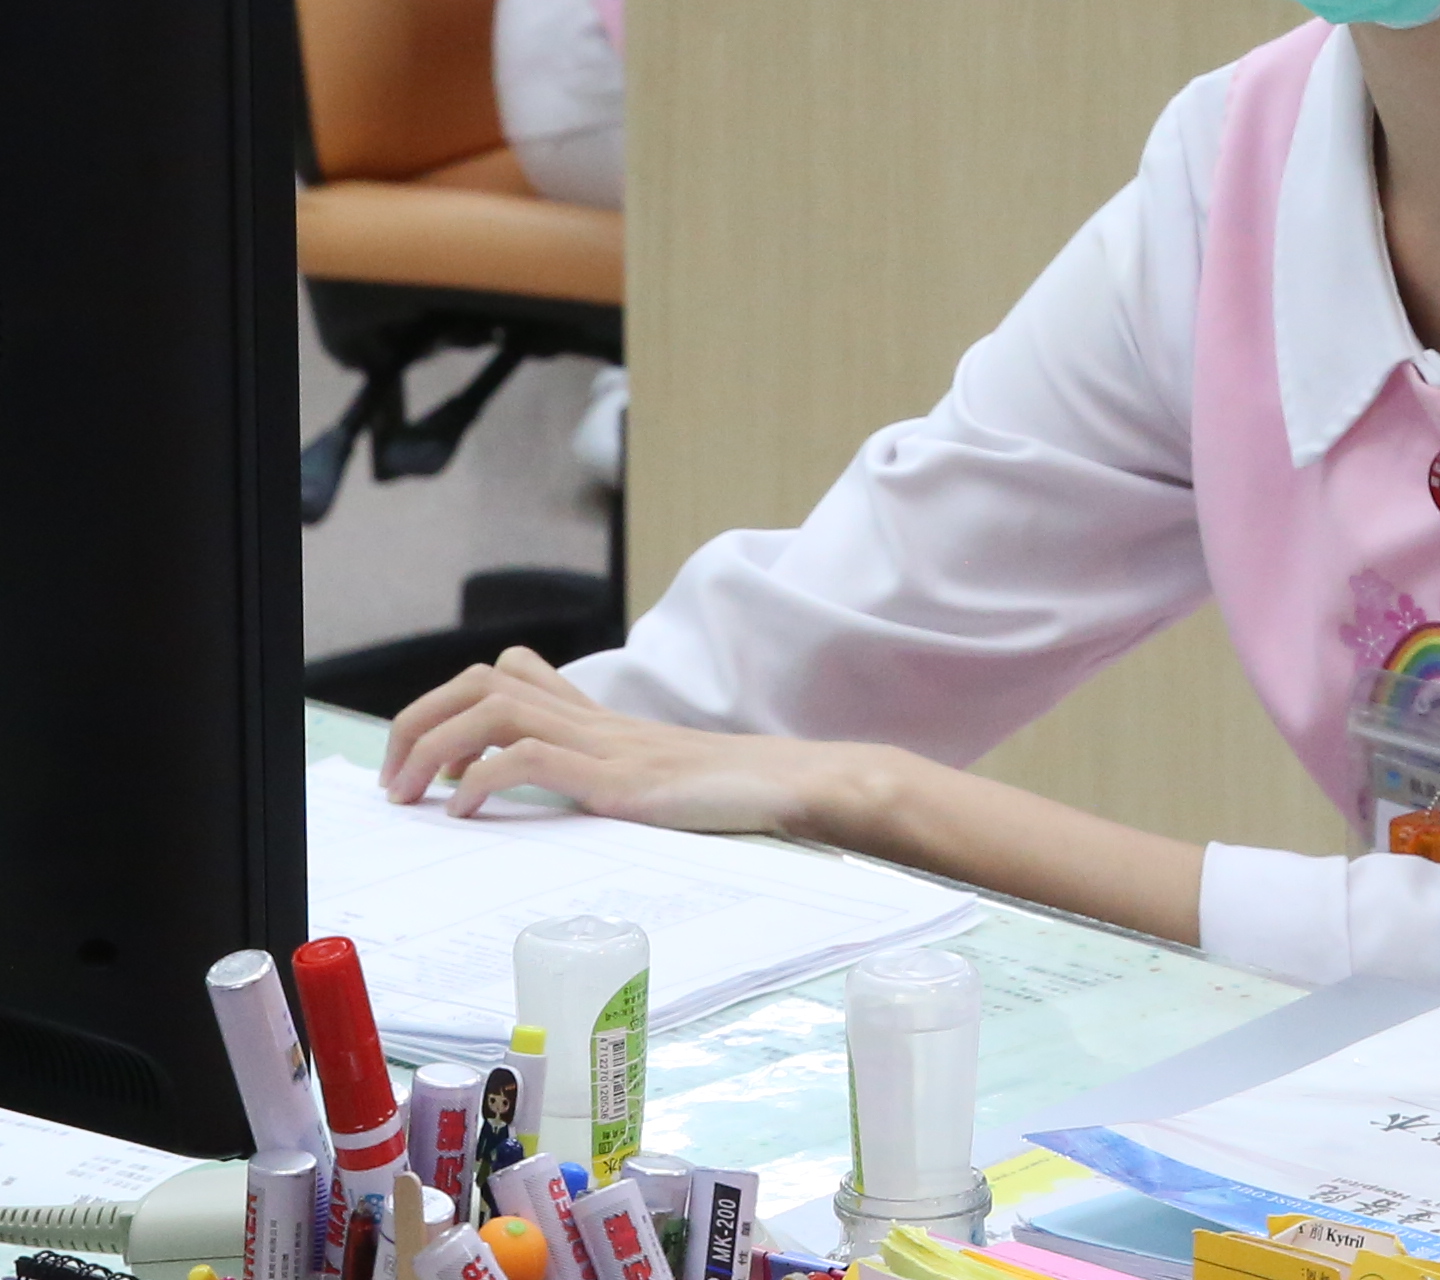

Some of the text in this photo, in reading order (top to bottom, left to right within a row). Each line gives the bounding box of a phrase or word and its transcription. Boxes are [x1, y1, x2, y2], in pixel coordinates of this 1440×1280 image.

[1329, 1176, 1413, 1201] Hospital
[712, 1194, 739, 1265] MK-200
[1326, 1226, 1366, 1249] Kytril
